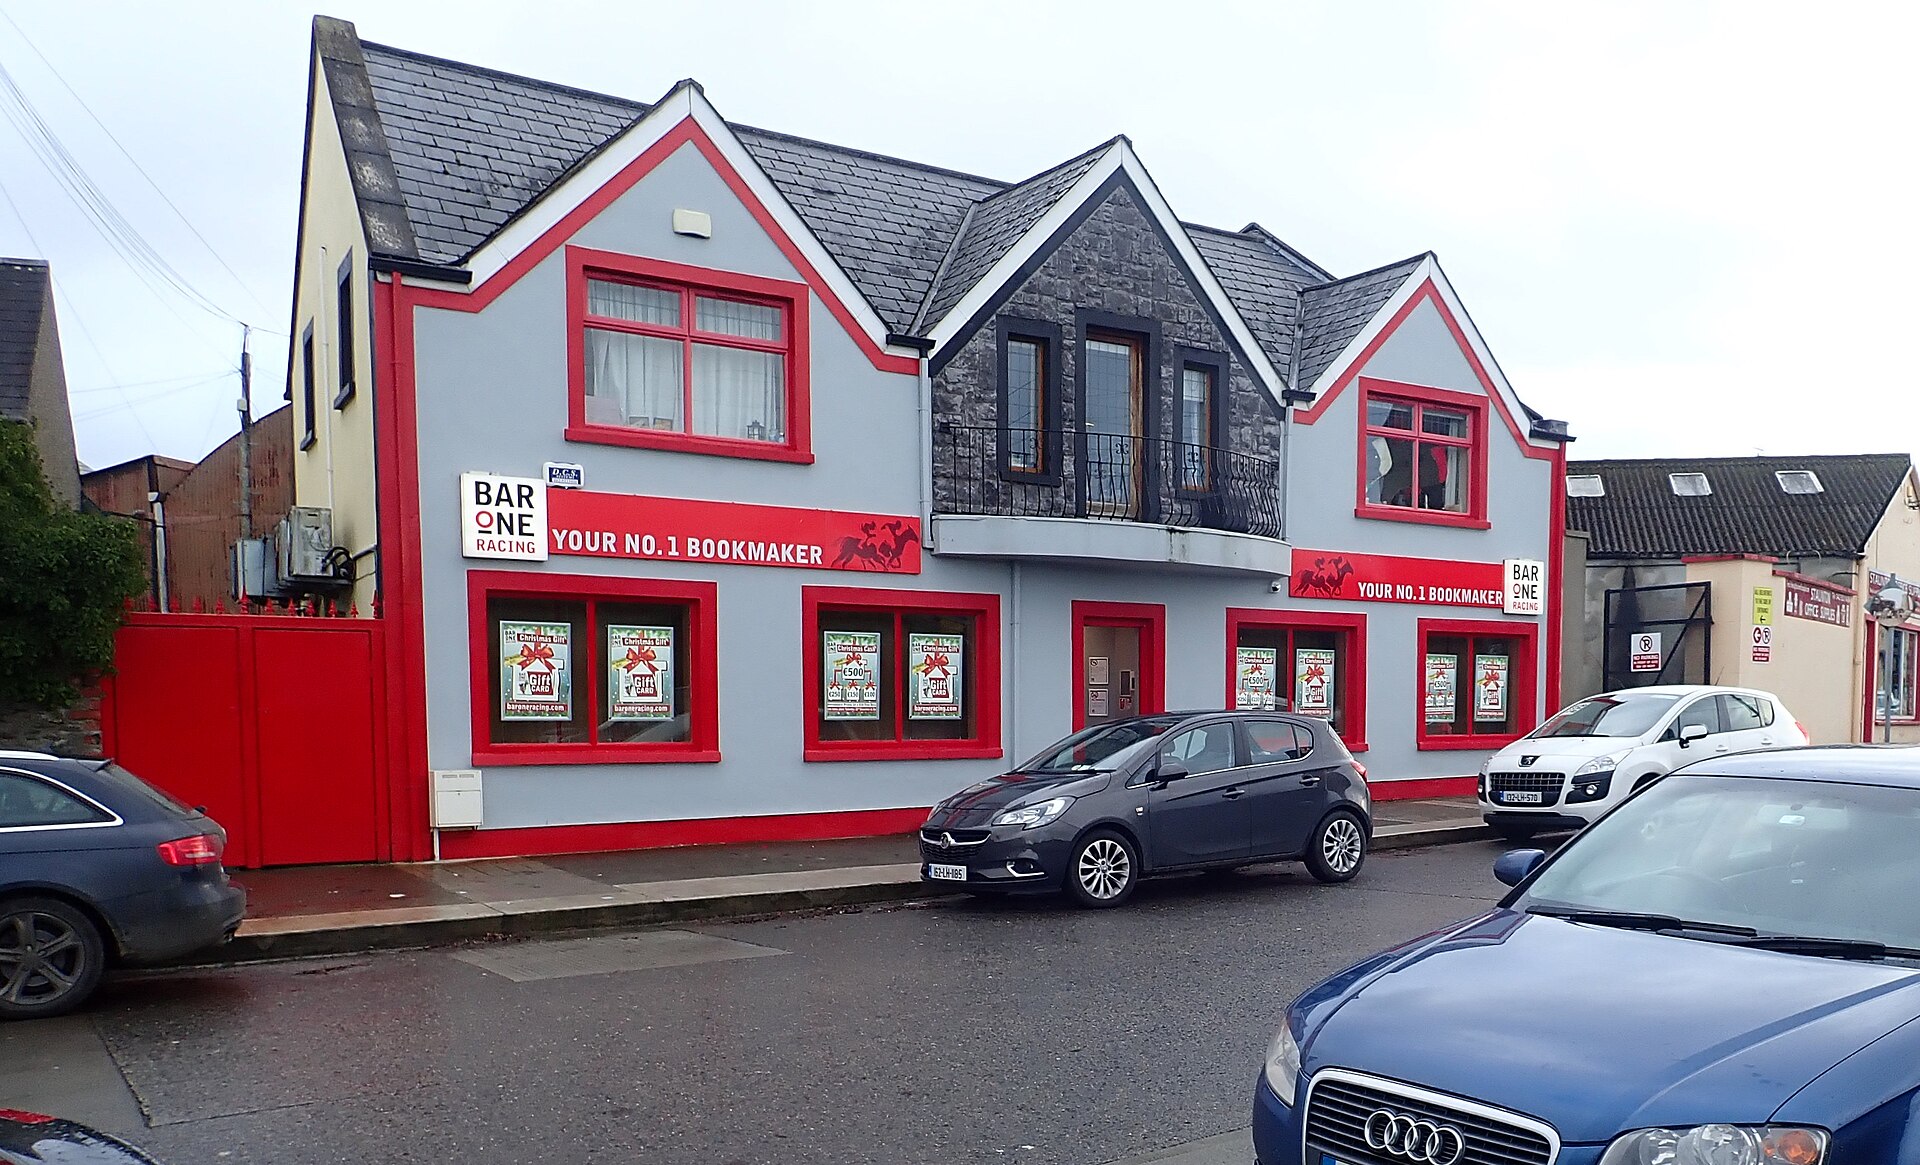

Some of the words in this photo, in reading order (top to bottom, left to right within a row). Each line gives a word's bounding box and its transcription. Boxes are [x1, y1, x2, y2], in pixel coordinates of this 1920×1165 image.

[474, 481, 535, 509] BAR
[475, 510, 535, 537] ONE
[477, 538, 536, 554] RACING
[552, 528, 617, 553] YOUR
[625, 533, 680, 557] NO.1
[687, 537, 823, 565] BOOKMAKER
[1513, 564, 1539, 582] BAR
[1358, 581, 1393, 599] YOUR
[1396, 584, 1426, 602] NO.1
[1429, 588, 1504, 605] BOOKMAKER
[1513, 583, 1538, 600] ONE
[1512, 601, 1539, 611] RACING
[519, 633, 552, 643] Christmas
[553, 635, 567, 644] Gift
[624, 637, 655, 646] Christmas
[655, 638, 668, 646] Gift
[843, 667, 864, 677] €500
[529, 673, 552, 687] Gift
[634, 676, 654, 688] Gift
[930, 680, 947, 690] Gift
[1248, 676, 1264, 685] €500
[1310, 687, 1323, 696] Gift
[506, 702, 565, 712] baroneracing.com
[614, 704, 668, 713] baroneracing.com
[1506, 793, 1538, 802] 132-LH-570
